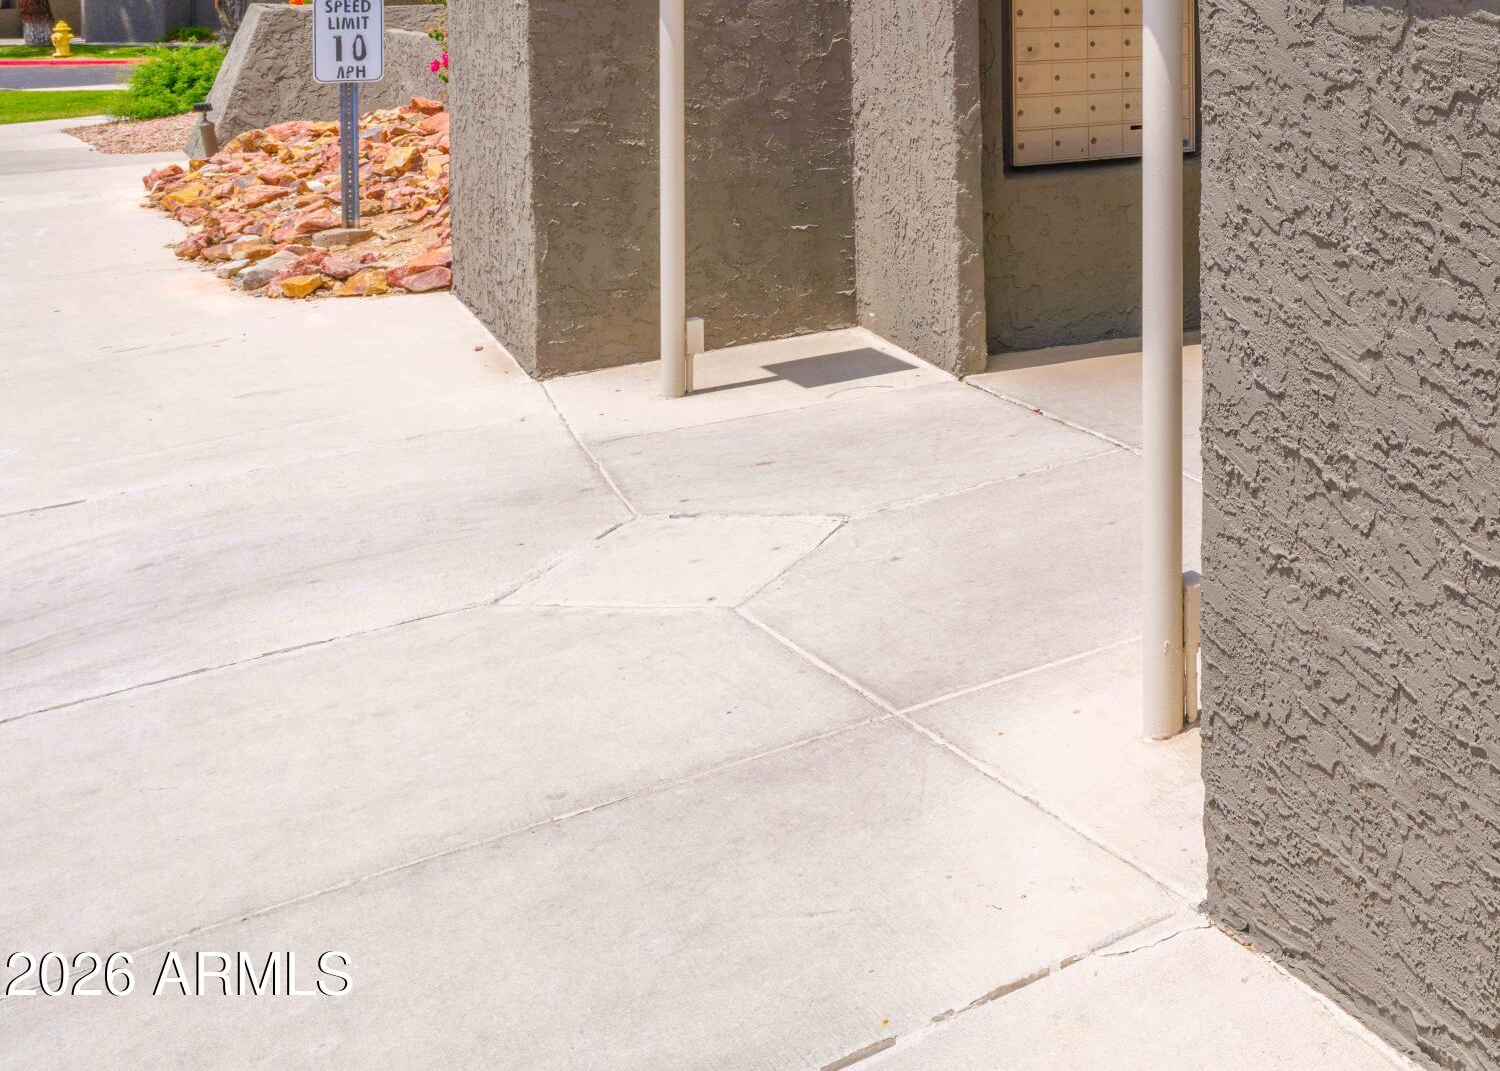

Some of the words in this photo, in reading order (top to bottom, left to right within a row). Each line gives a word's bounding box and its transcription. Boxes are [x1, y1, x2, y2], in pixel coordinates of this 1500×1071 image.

[325, 0, 371, 14] SPEED
[328, 16, 370, 30] LIMIT
[332, 34, 367, 62] 10
